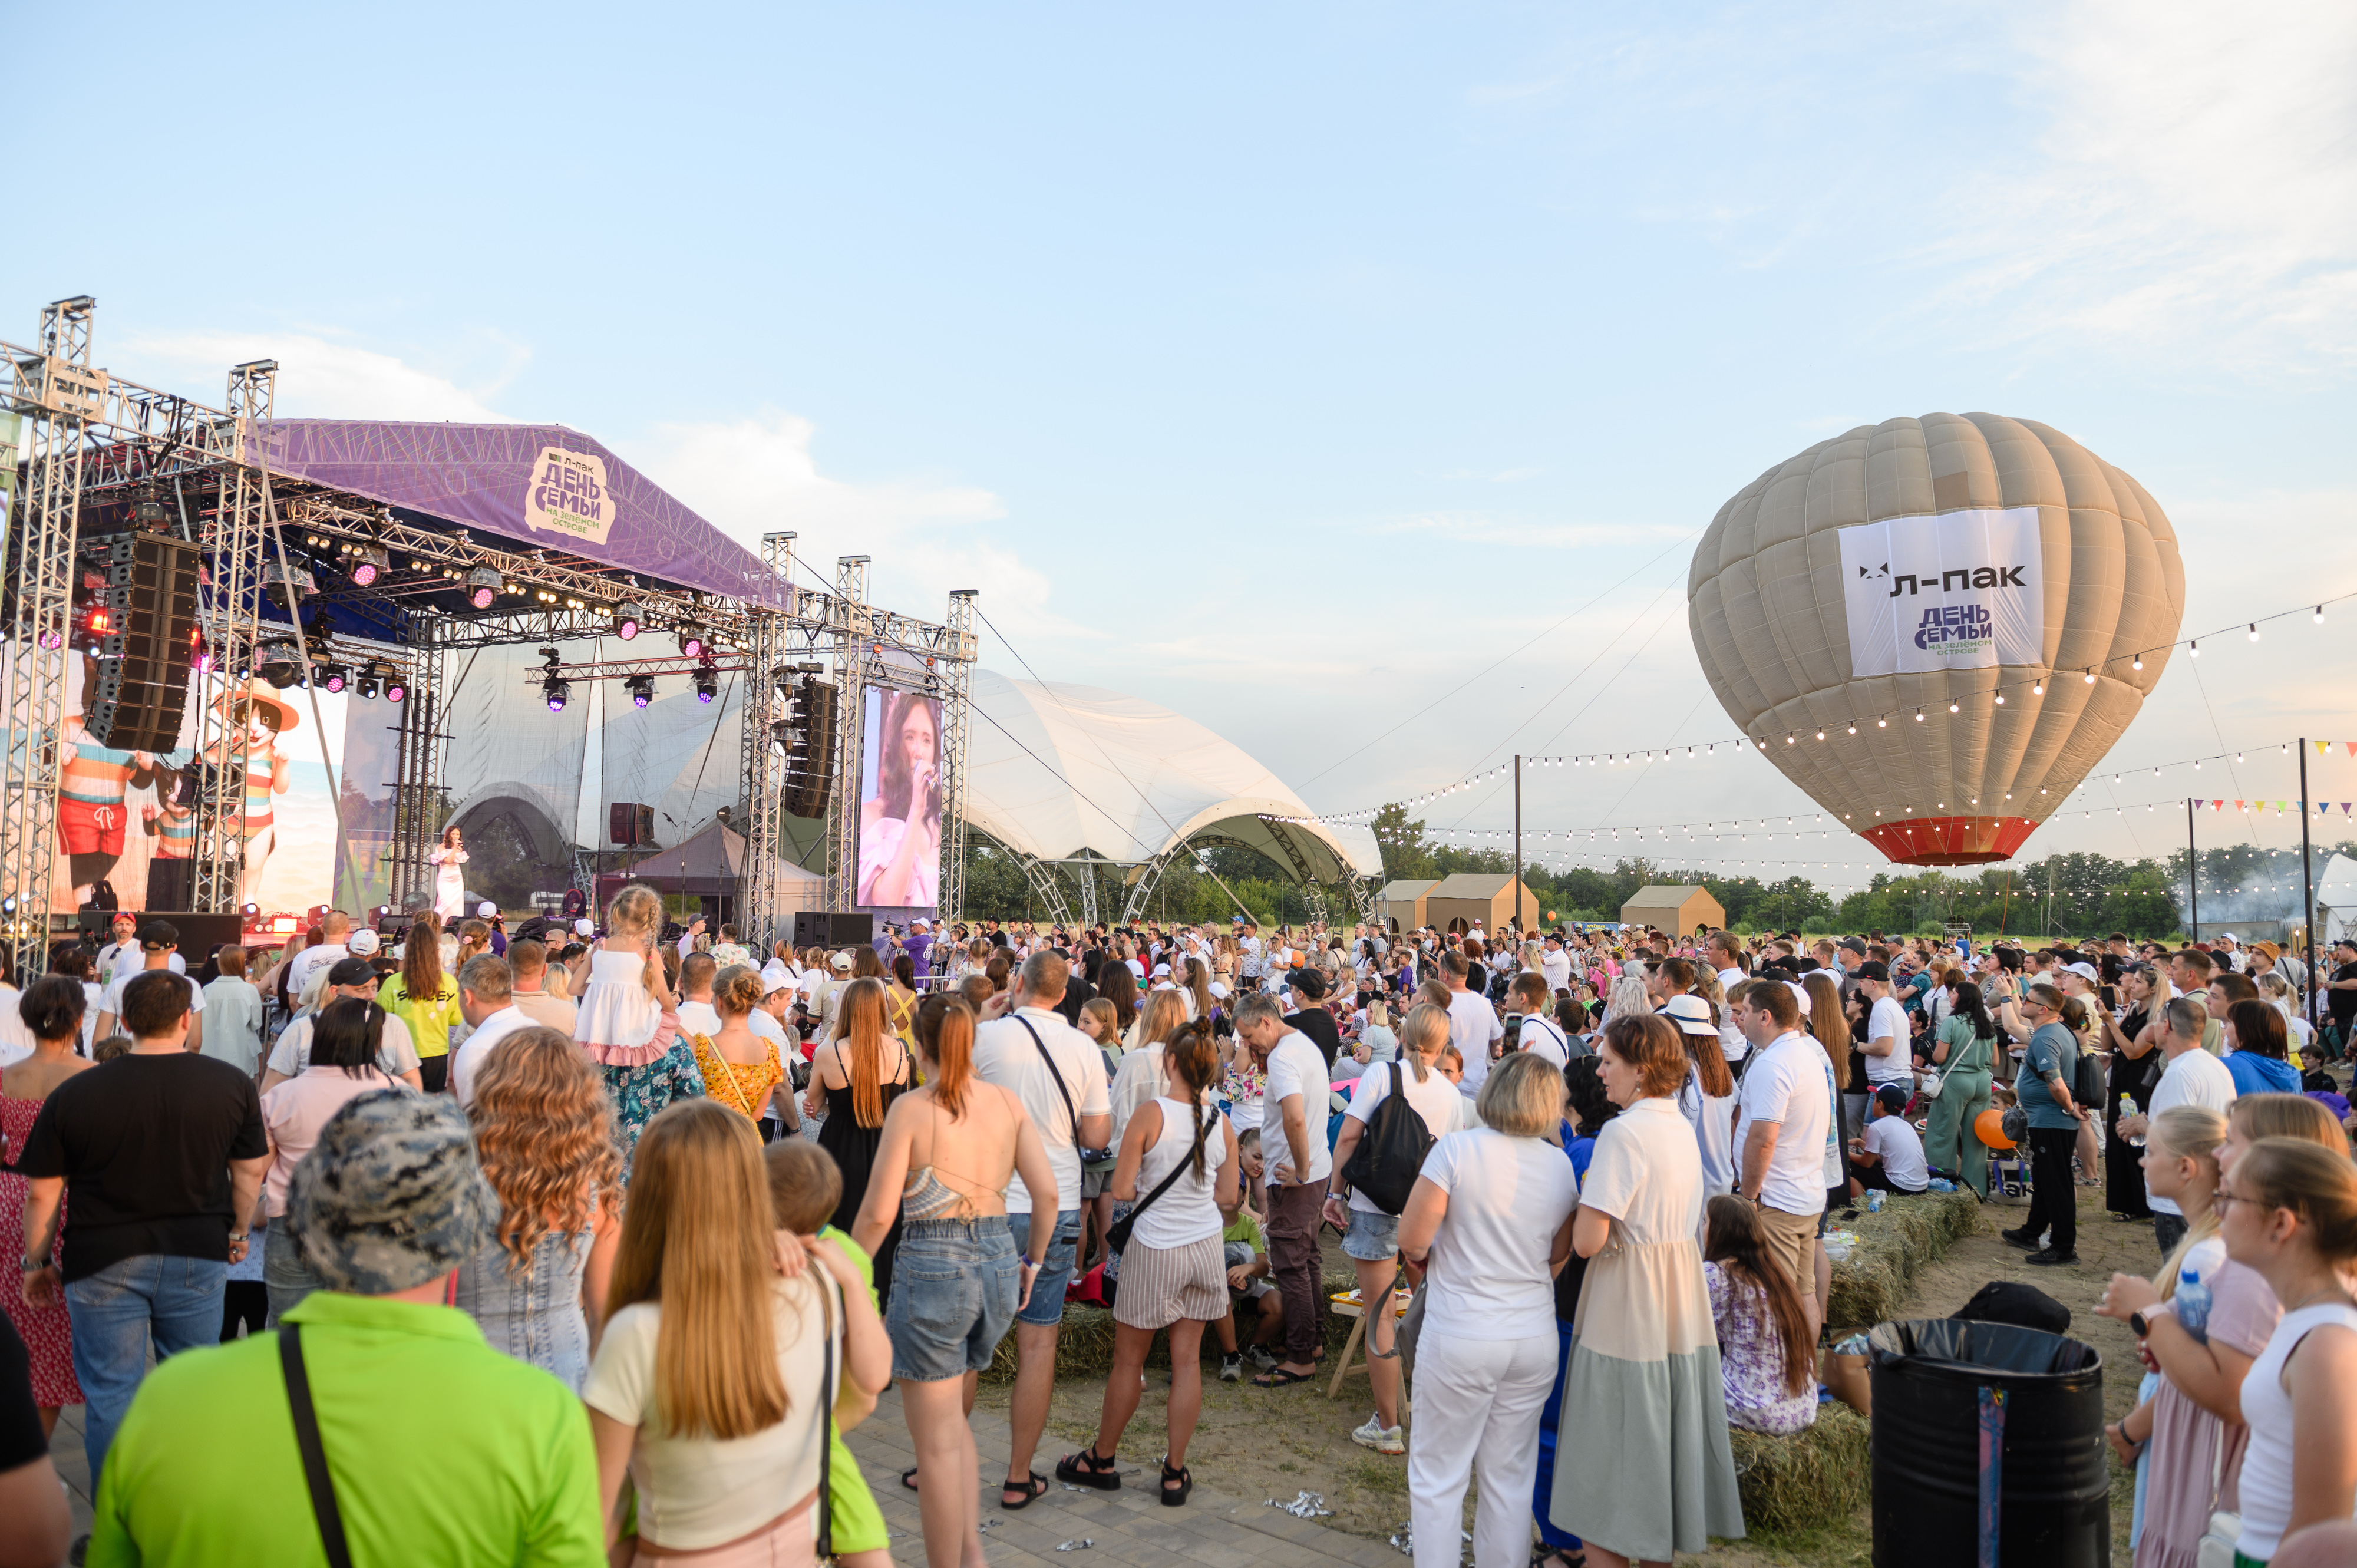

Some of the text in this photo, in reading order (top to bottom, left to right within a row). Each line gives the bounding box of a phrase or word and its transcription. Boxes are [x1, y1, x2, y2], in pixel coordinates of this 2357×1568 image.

[564, 457, 594, 474] л-пак
[540, 462, 600, 500] ДЕНЬ
[535, 486, 601, 520] СЕМЬИ
[546, 507, 558, 517] НА
[553, 517, 588, 534] ОСТРОВЕ
[1890, 565, 2027, 598] л-пак
[1919, 604, 1990, 629] ДЕНЬ
[1914, 622, 1992, 650] СЕМЬИ
[1937, 648, 1979, 656] ОСТРОВЕ
